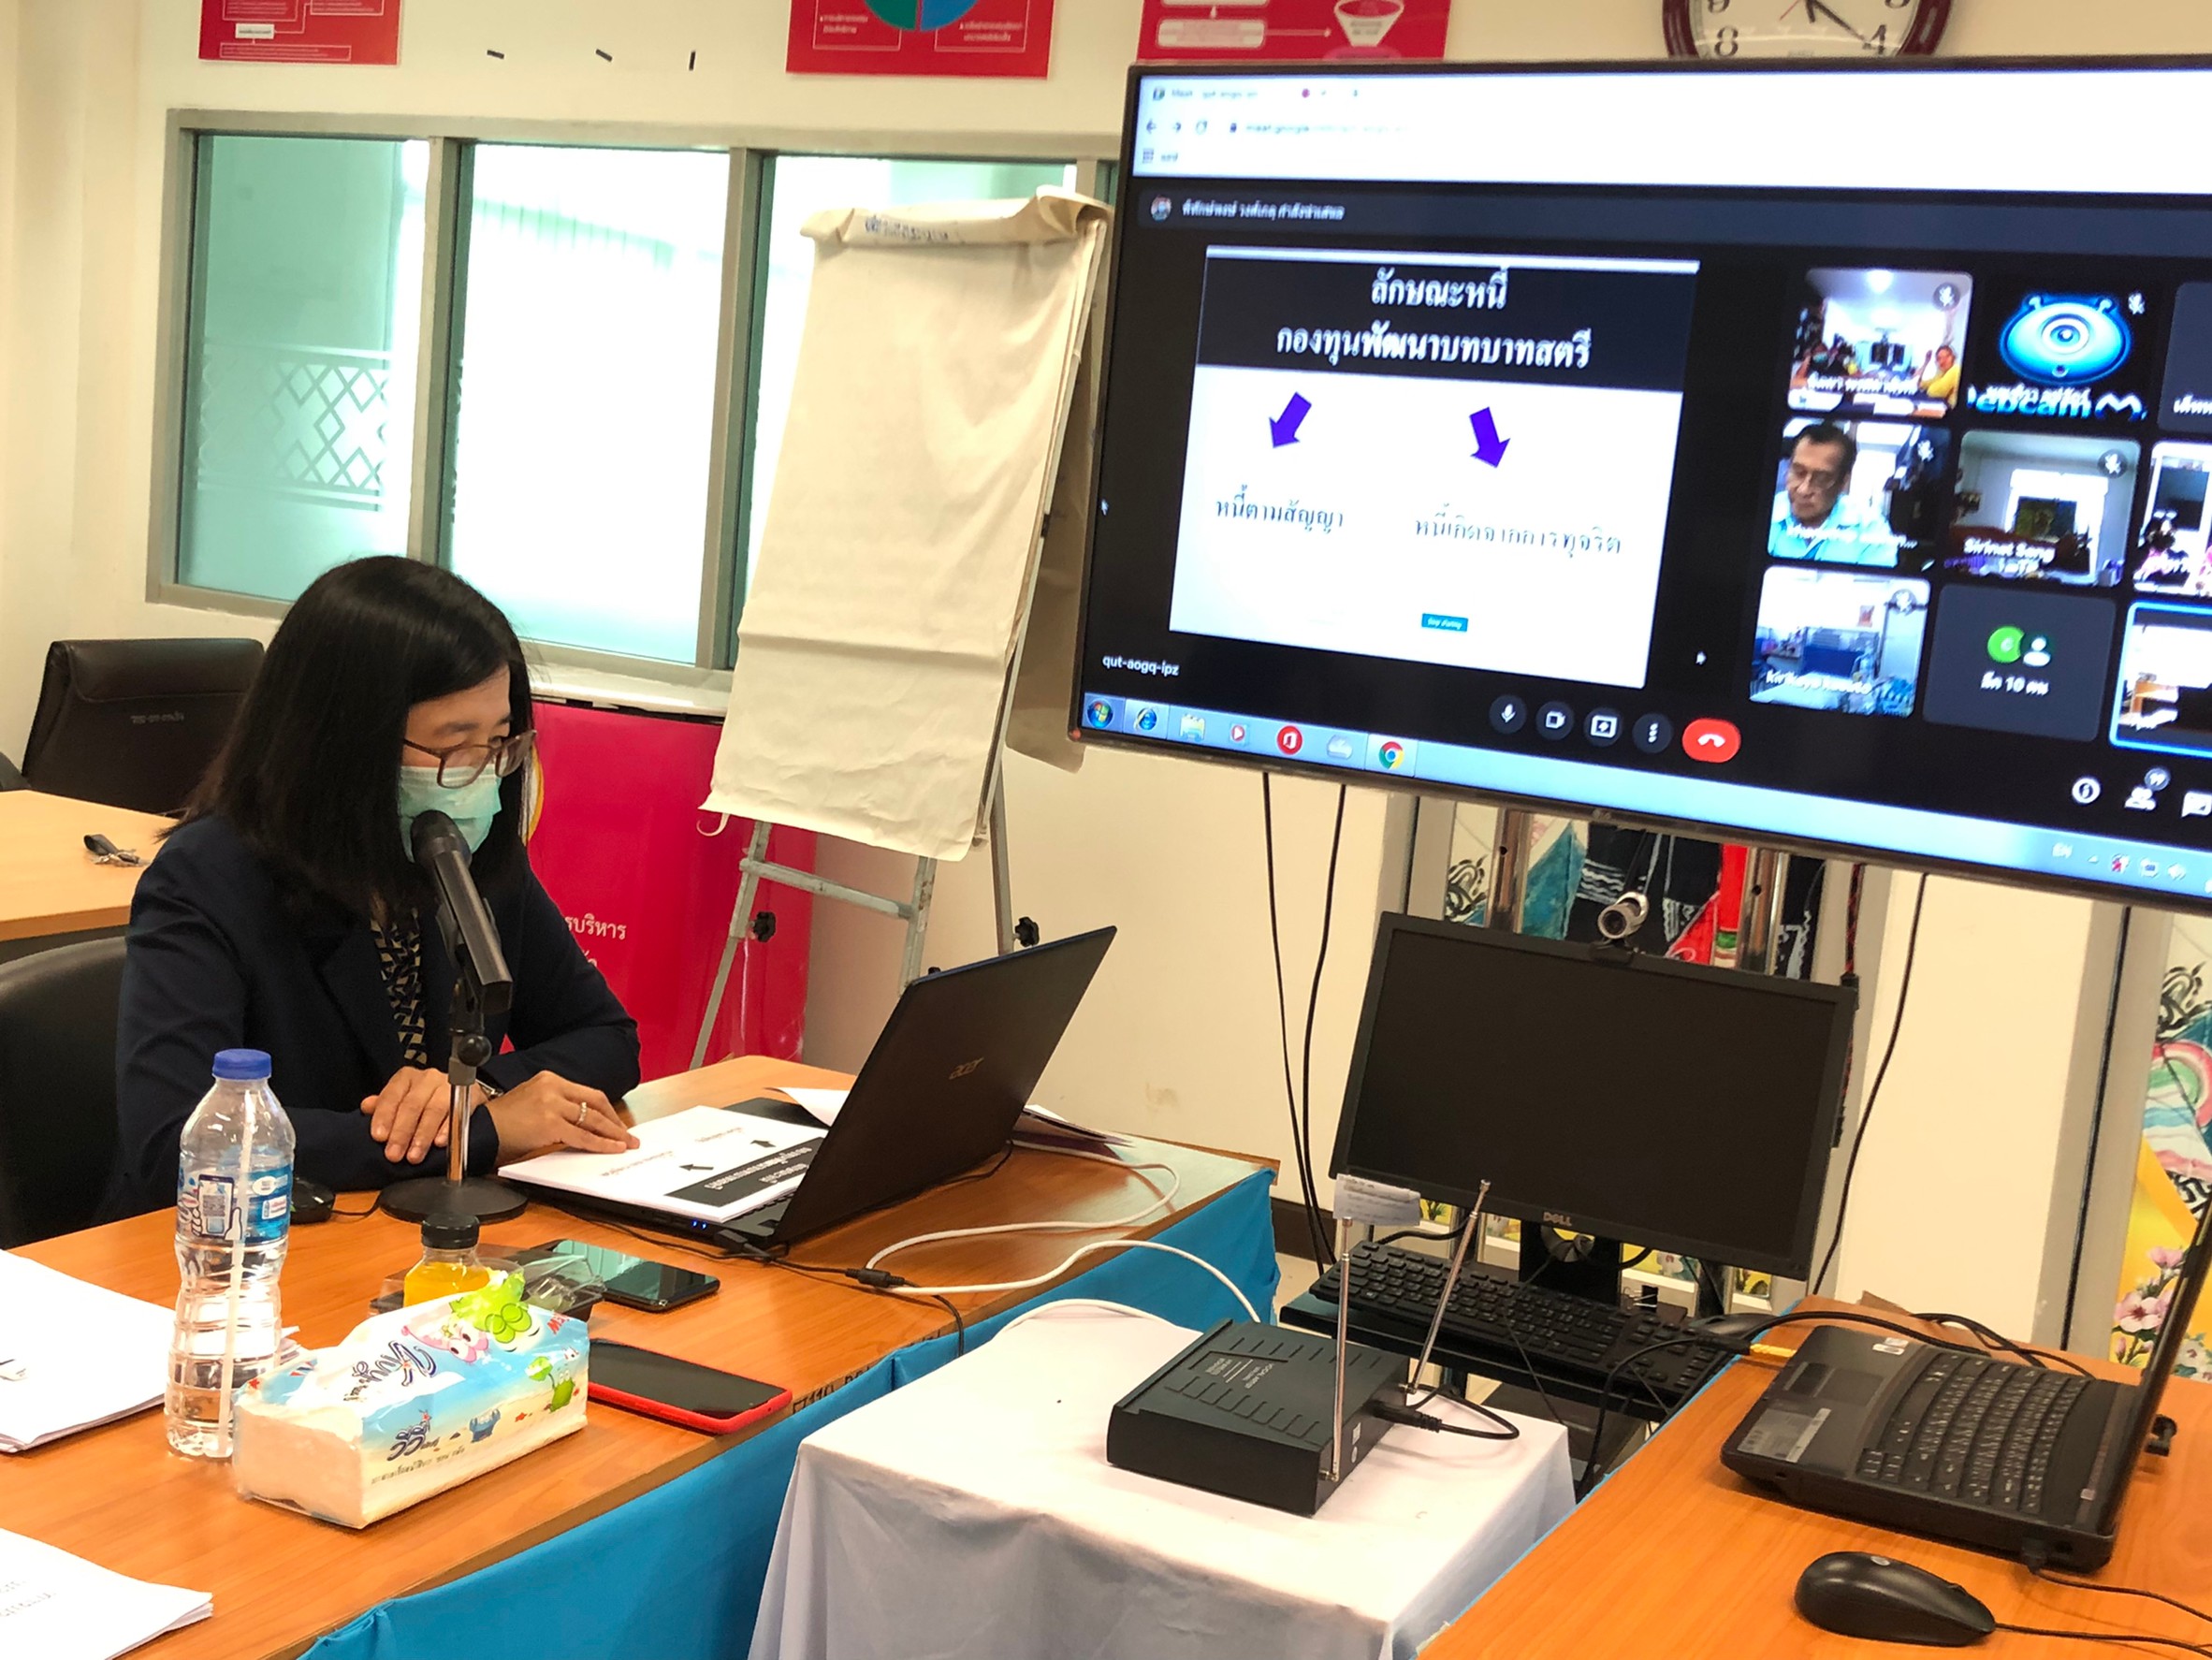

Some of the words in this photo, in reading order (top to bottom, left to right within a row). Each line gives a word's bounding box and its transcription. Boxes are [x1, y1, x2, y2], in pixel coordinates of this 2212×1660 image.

[1371, 265, 1509, 310] ลักษณะหนี้
[1276, 319, 1592, 370] กองทุนพัฒนาบทบาทสตรี
[1215, 483, 1345, 533] หนี้ตามสัญญา
[1416, 502, 1622, 559] หนี้เกิดจากการทุจริต
[1102, 654, 1180, 677] qut-aogq-ipz
[1543, 1211, 1572, 1227] DELL
